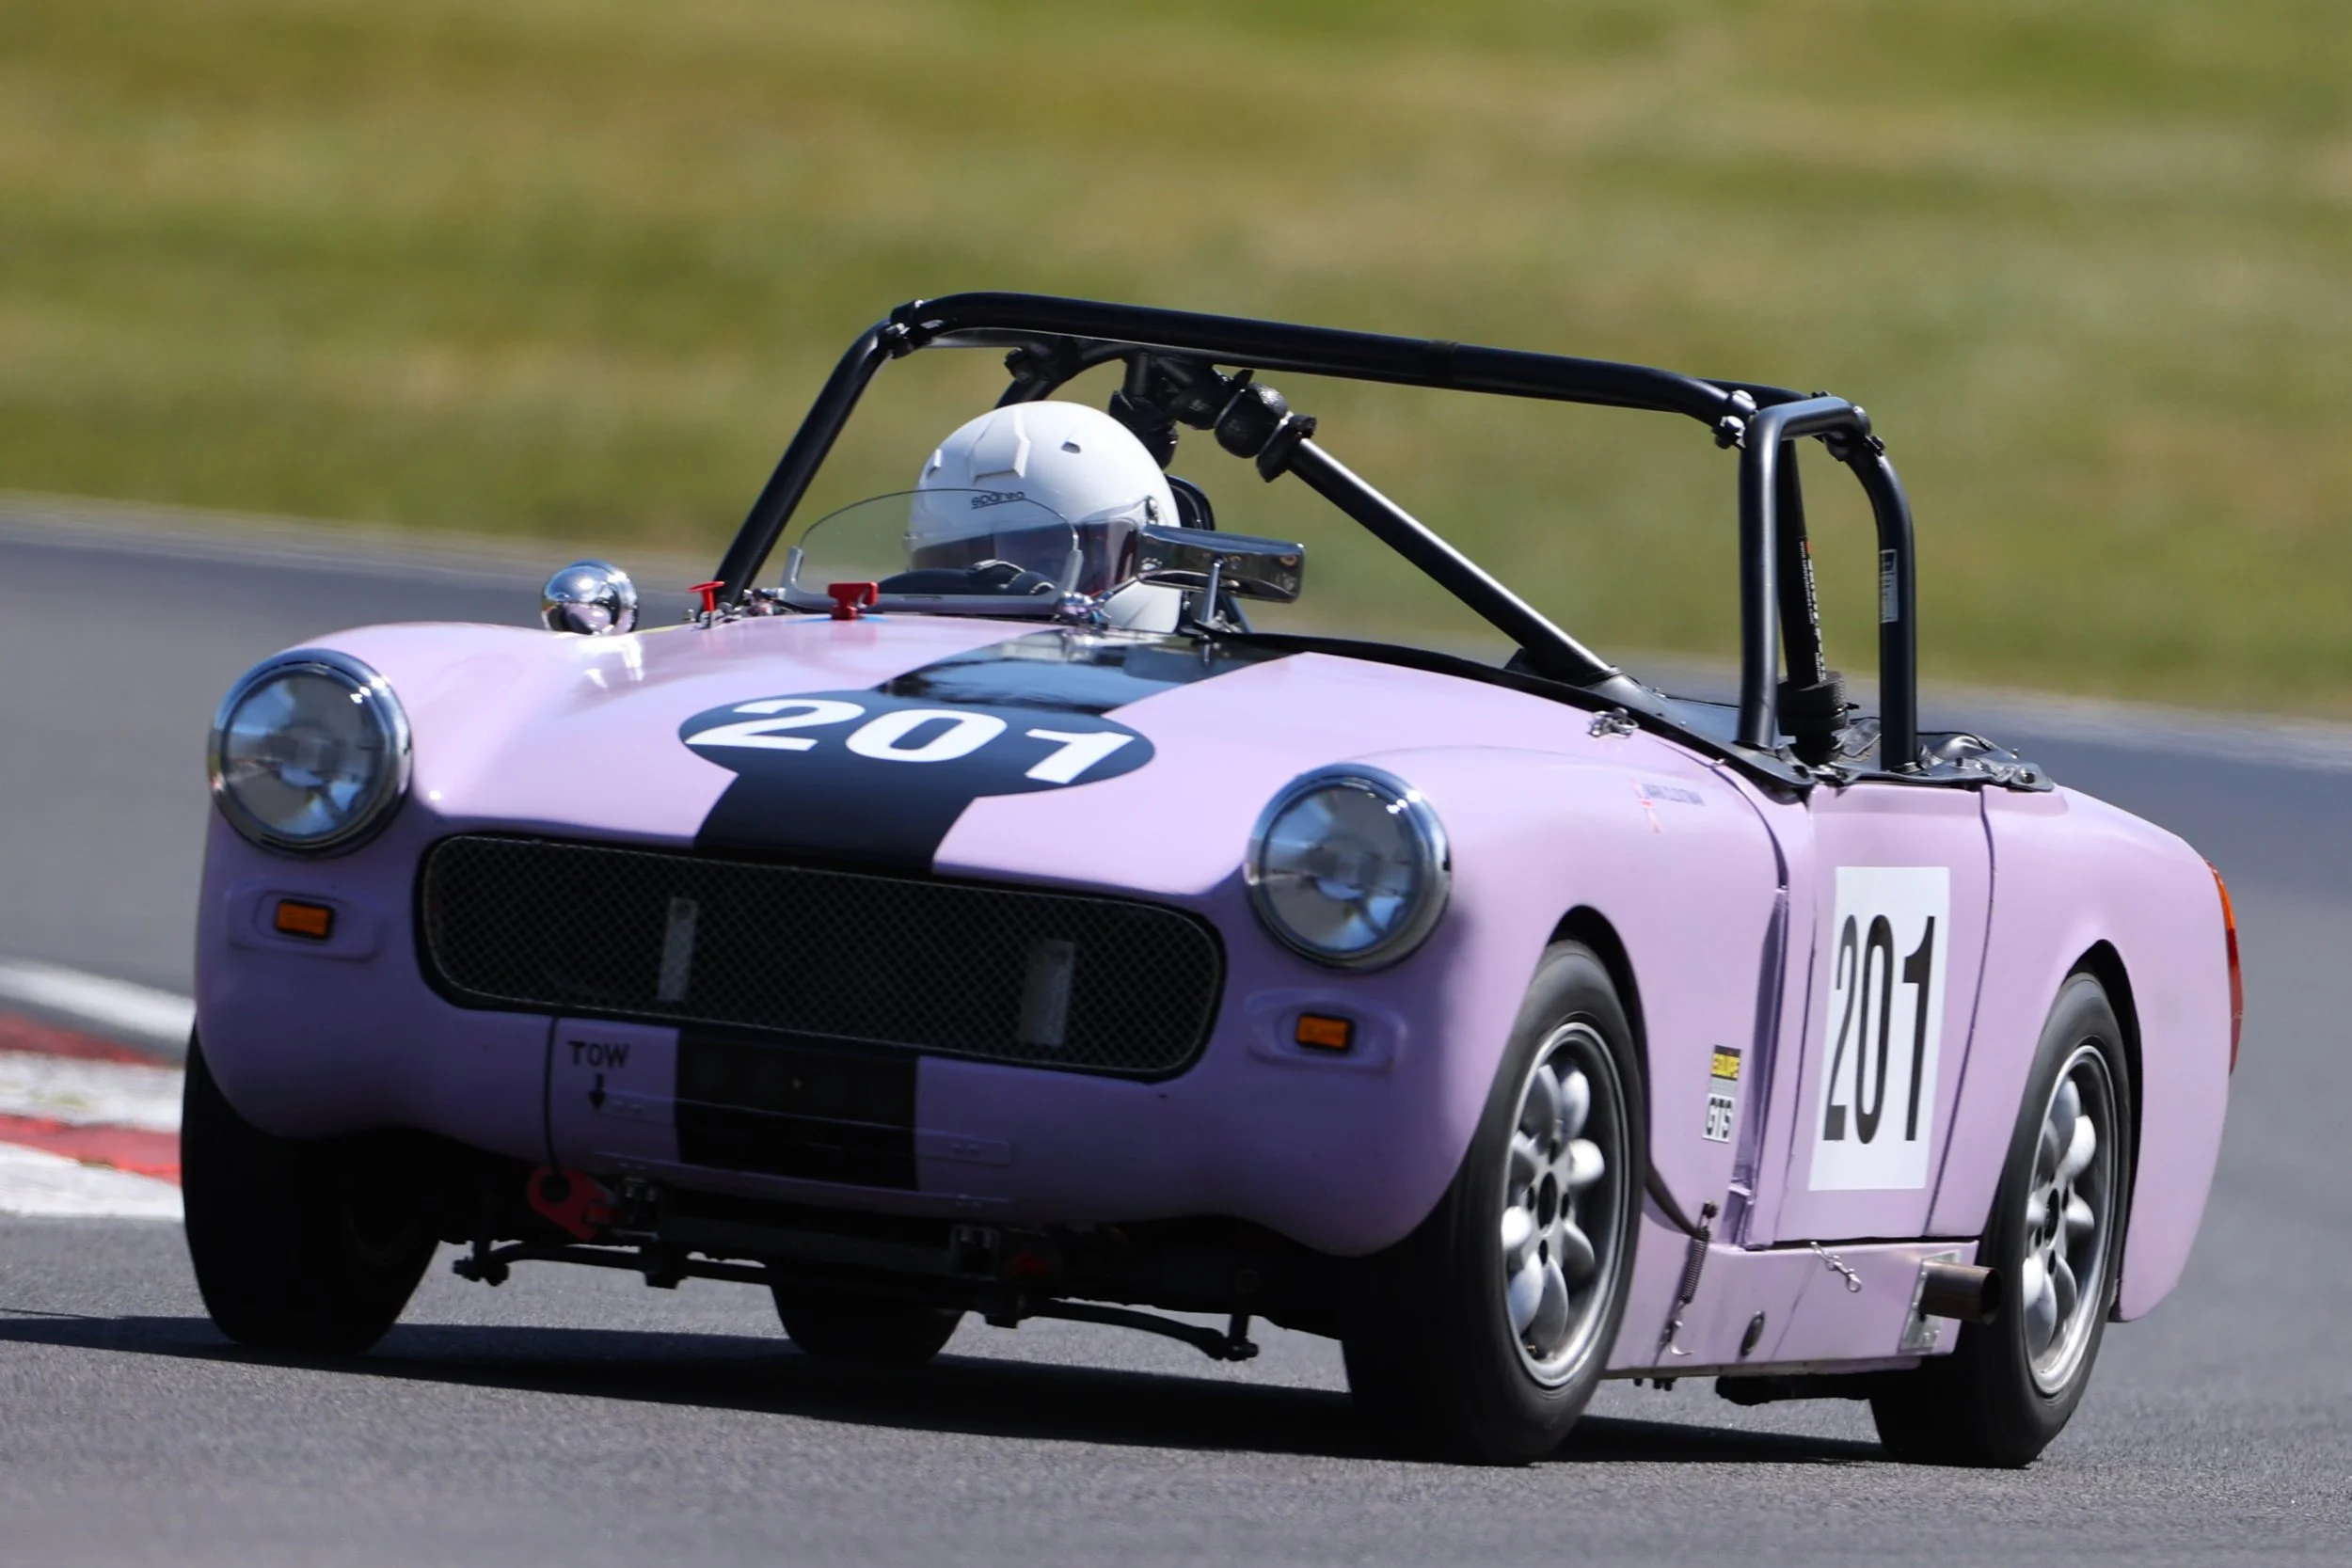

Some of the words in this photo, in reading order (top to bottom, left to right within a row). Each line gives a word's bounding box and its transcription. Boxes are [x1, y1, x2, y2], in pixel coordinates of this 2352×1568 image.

[685, 699, 1135, 784] 201
[567, 1039, 631, 1069] TOW
[1823, 913, 1936, 1145] 201
[1706, 1096, 1733, 1140] GTS
